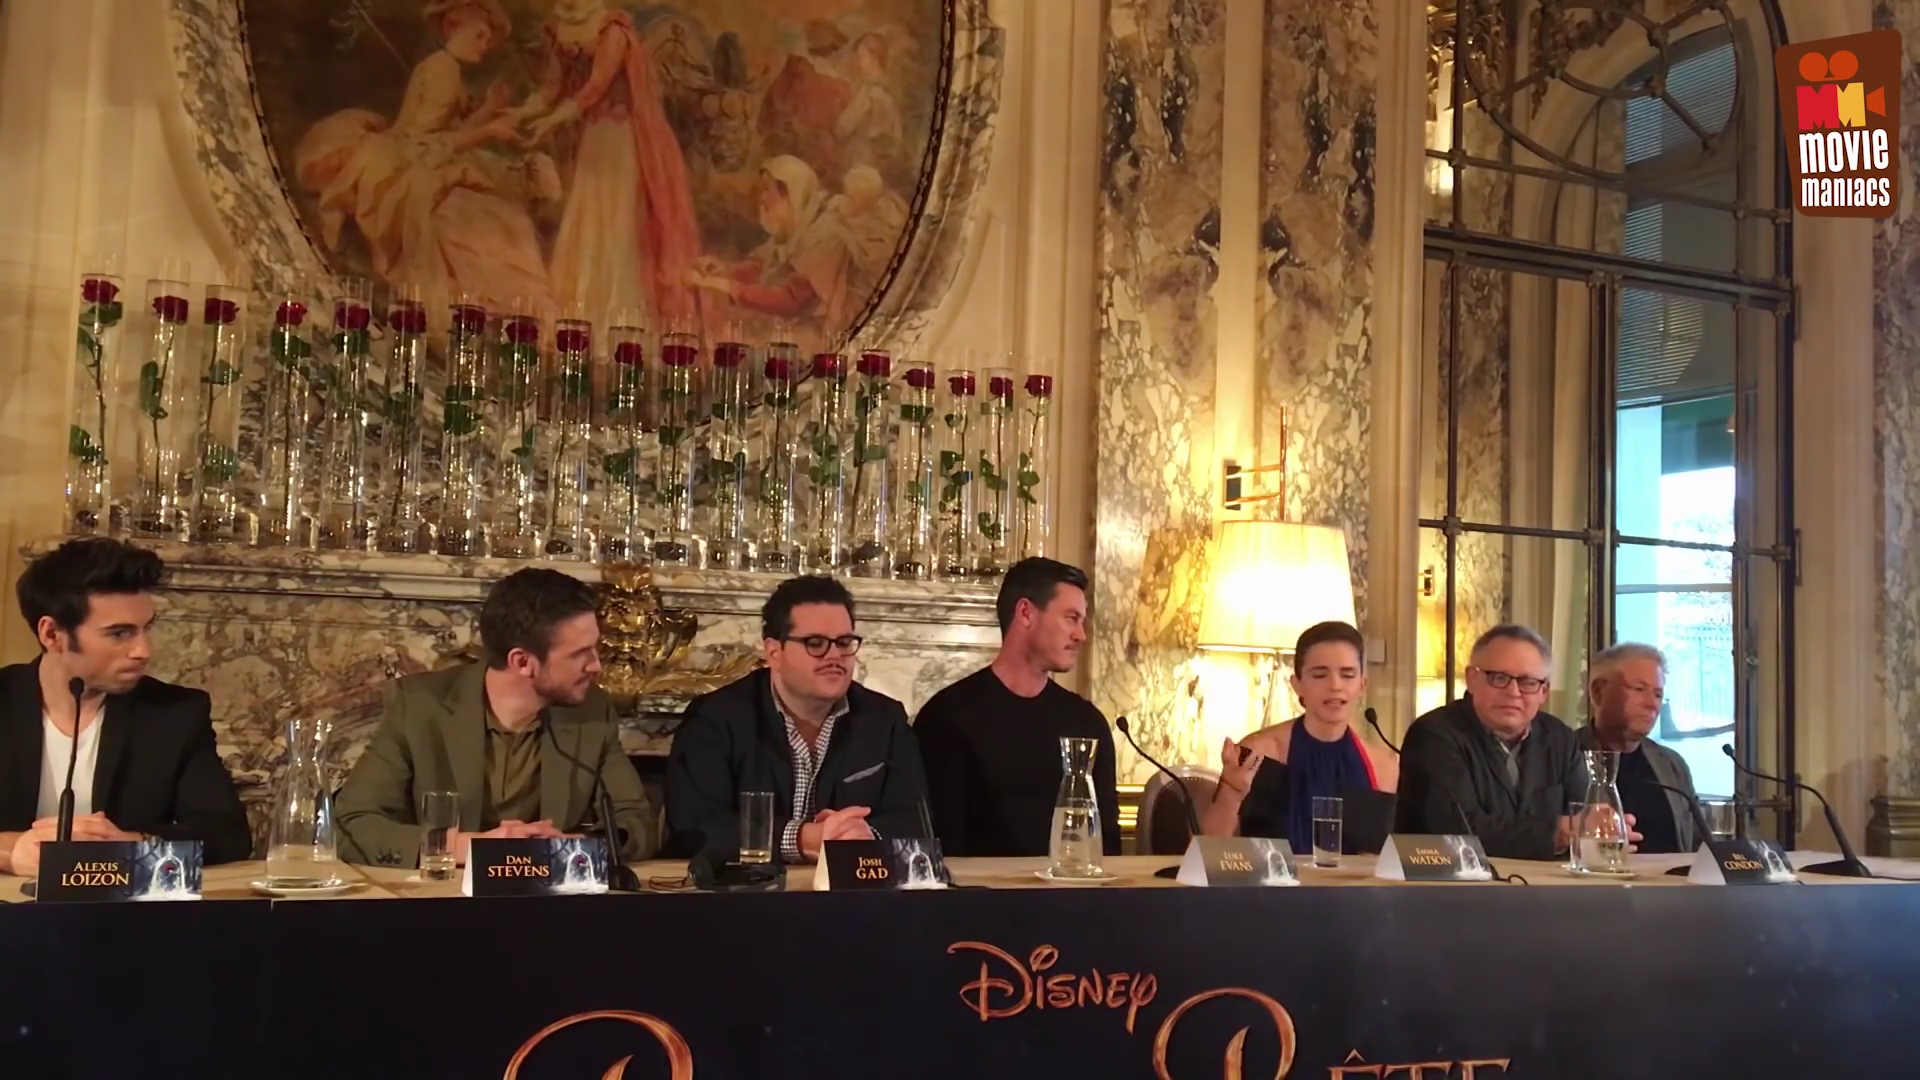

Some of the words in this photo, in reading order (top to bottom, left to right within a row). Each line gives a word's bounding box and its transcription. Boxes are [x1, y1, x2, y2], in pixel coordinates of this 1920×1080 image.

[506, 855, 532, 865] DAN
[858, 857, 882, 868] JOSH
[1220, 860, 1254, 871] EVANS
[1409, 855, 1452, 865] WATSON
[73, 861, 119, 872] ALEXIS
[488, 865, 550, 877] STEVENS
[1724, 861, 1764, 871] CONDON
[856, 868, 889, 879] GAD
[61, 873, 129, 887] LOIZON
[947, 940, 1158, 1035] Disney
